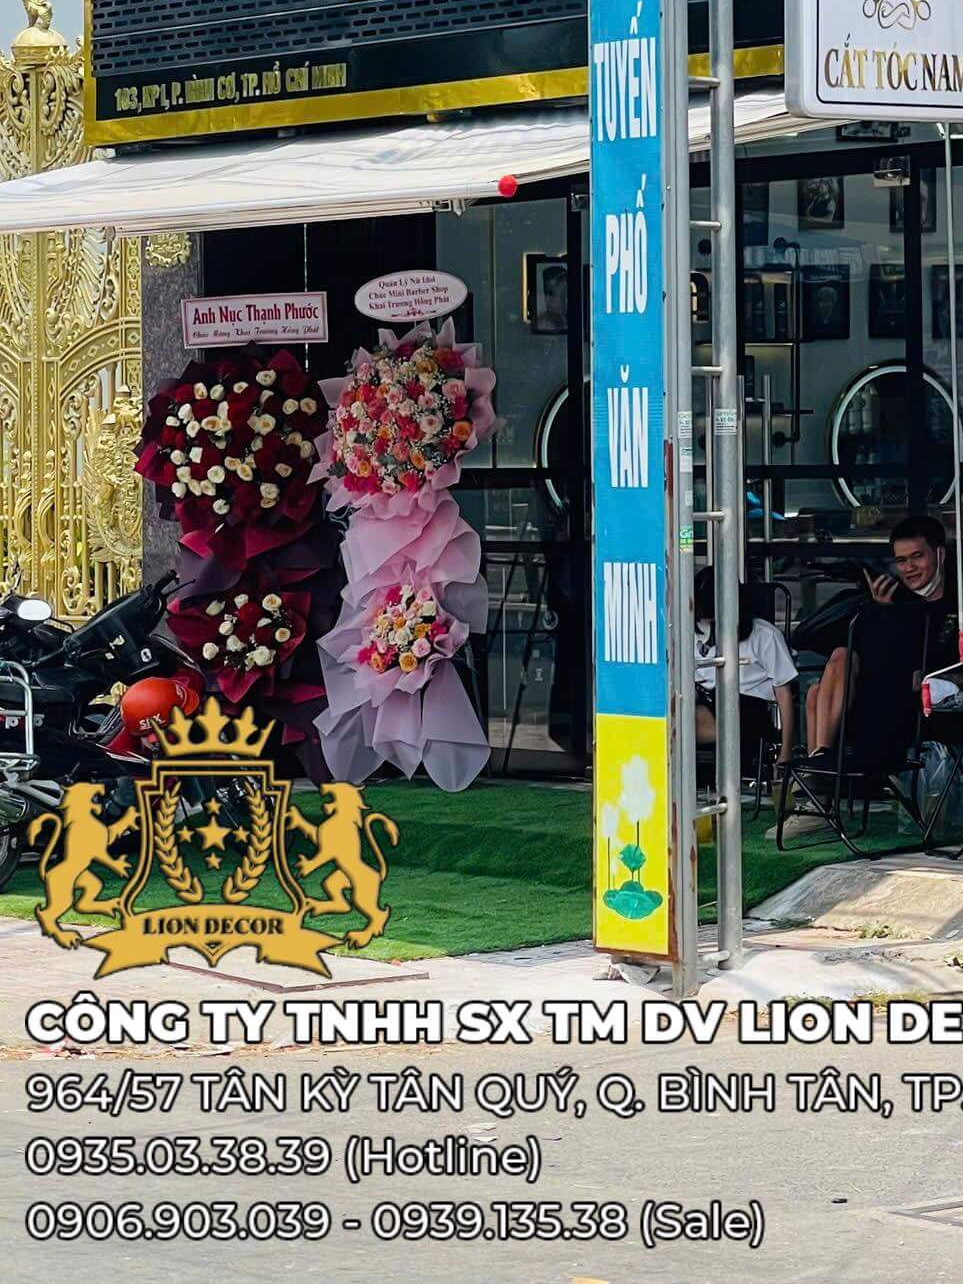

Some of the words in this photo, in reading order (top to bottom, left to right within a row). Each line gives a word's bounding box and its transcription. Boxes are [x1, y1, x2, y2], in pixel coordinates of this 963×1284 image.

[594, 0, 657, 142] TUYẾN
[824, 33, 868, 89] CẮT
[872, 42, 917, 91] TÓC
[605, 173, 649, 315] PHỐ
[193, 307, 216, 325] Anh
[246, 303, 281, 325] Thạnh
[285, 302, 319, 320] Phước
[607, 364, 649, 488] VĂN
[603, 562, 658, 665] MINH
